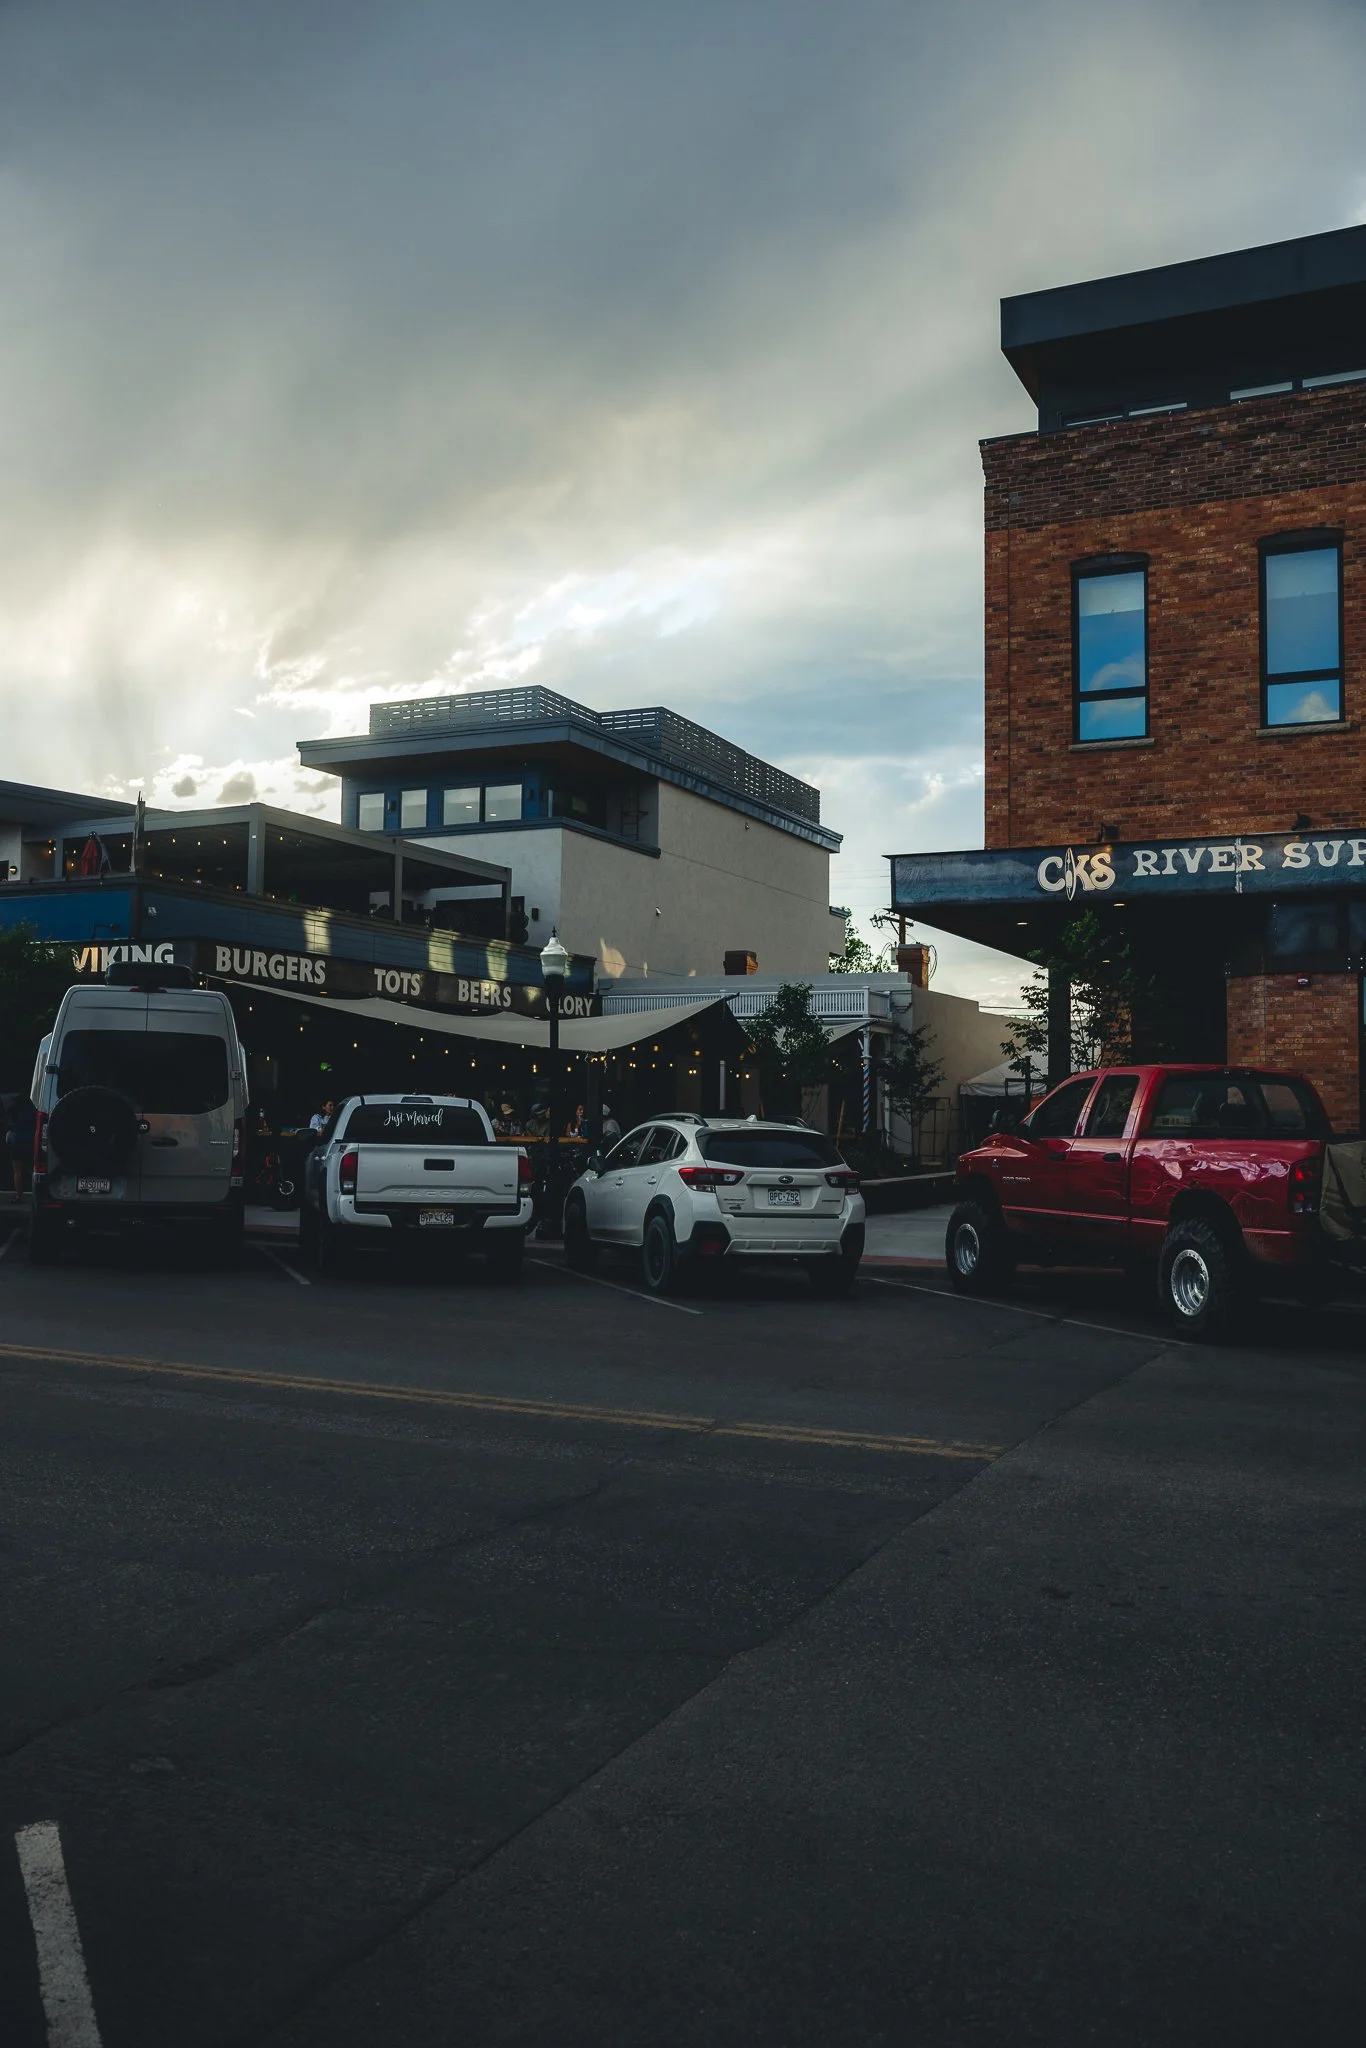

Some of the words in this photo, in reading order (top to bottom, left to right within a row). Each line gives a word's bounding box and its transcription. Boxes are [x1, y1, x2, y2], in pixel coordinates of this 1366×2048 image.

[1037, 852, 1116, 892] CKS
[1132, 845, 1265, 876] RIVER
[71, 943, 174, 973] VIKING
[216, 945, 326, 985] BURGERS
[374, 968, 421, 996] TOTS
[458, 979, 512, 1008] BEERS
[545, 995, 593, 1017] LORY
[391, 1189, 486, 1198] TACOMA
